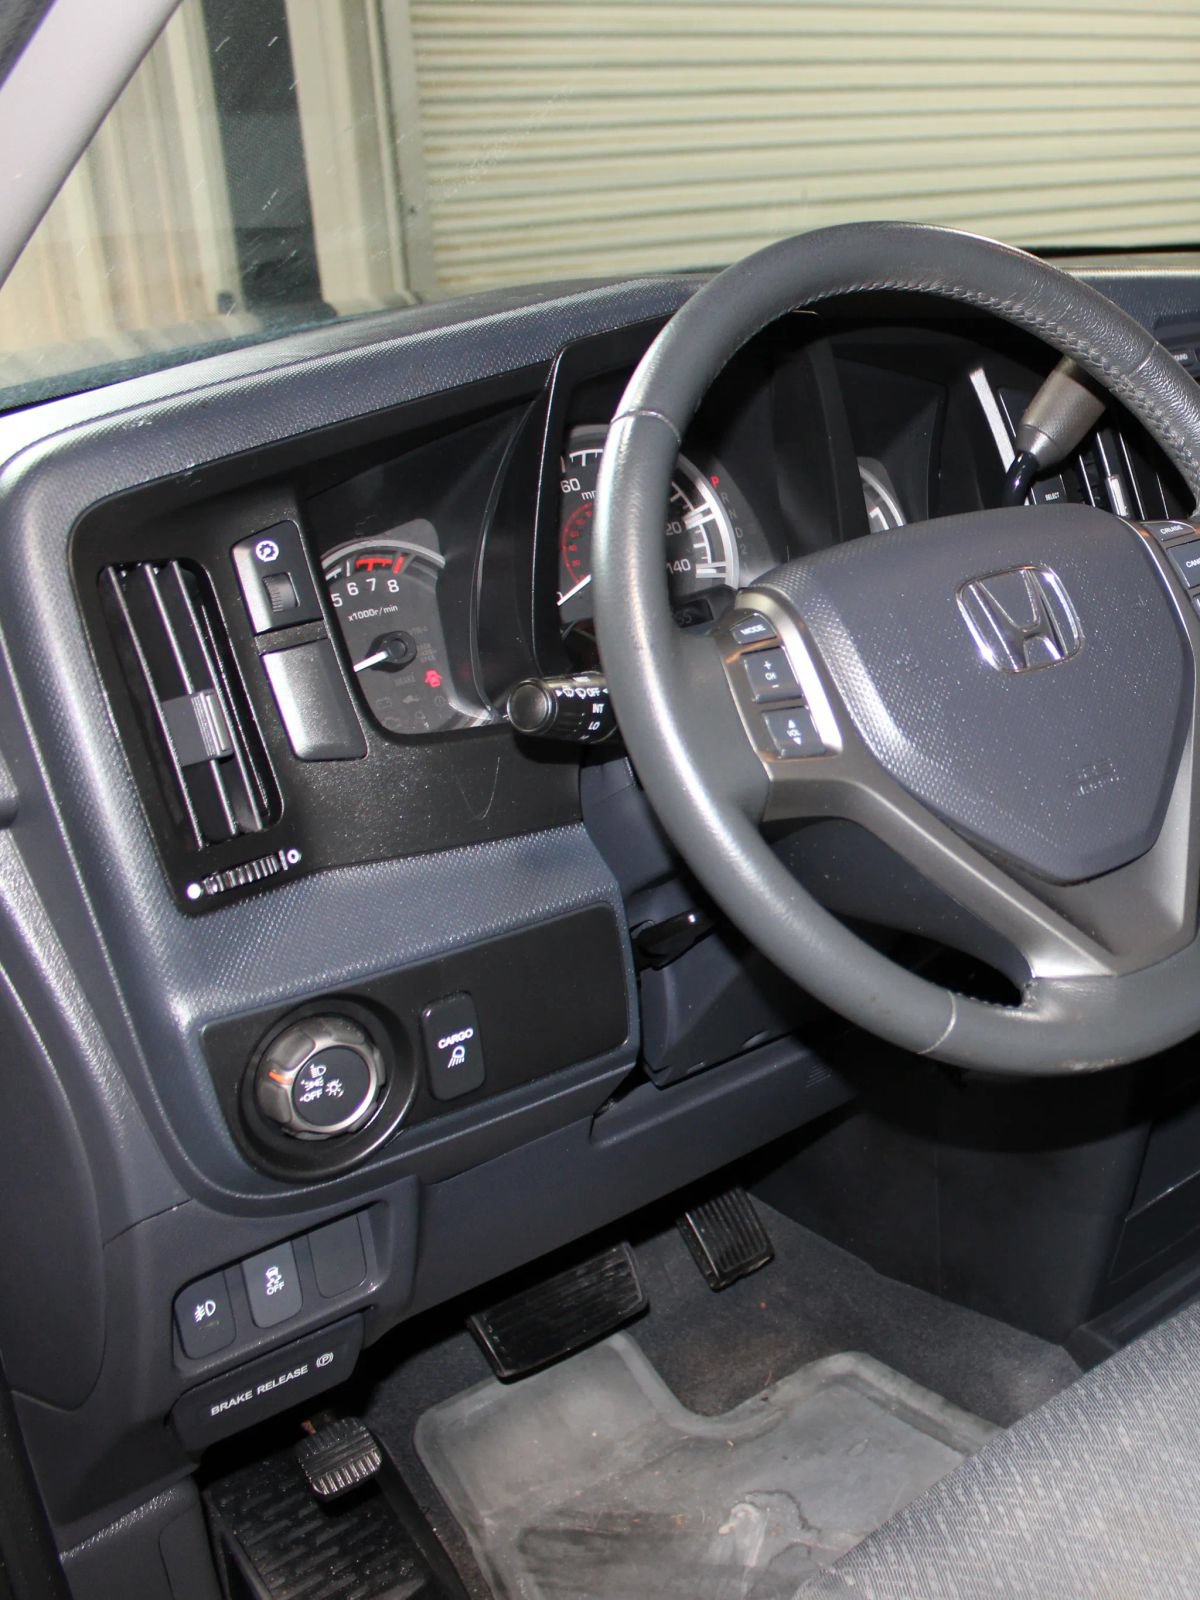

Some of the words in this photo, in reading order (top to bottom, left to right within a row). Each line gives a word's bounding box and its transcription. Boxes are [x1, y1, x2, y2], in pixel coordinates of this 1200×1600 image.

[560, 477, 581, 494] 60
[710, 475, 720, 488] P
[1044, 491, 1060, 501] SELECT
[1160, 525, 1184, 534] CRUISE
[331, 593, 343, 607] 5
[347, 582, 359, 596] 6
[366, 578, 377, 592] 7
[387, 579, 400, 593] 8
[740, 623, 766, 636] MODE
[764, 671, 777, 681] CH
[586, 688, 600, 698] OFF
[592, 703, 605, 714] INT
[588, 721, 601, 731] LO
[786, 728, 802, 738] VOL
[438, 1027, 474, 1049] CARGO
[303, 1089, 323, 1102] OFF
[266, 1281, 285, 1296] OFF
[211, 1389, 253, 1417] BRAKE
[256, 1364, 309, 1396] RELEASE
